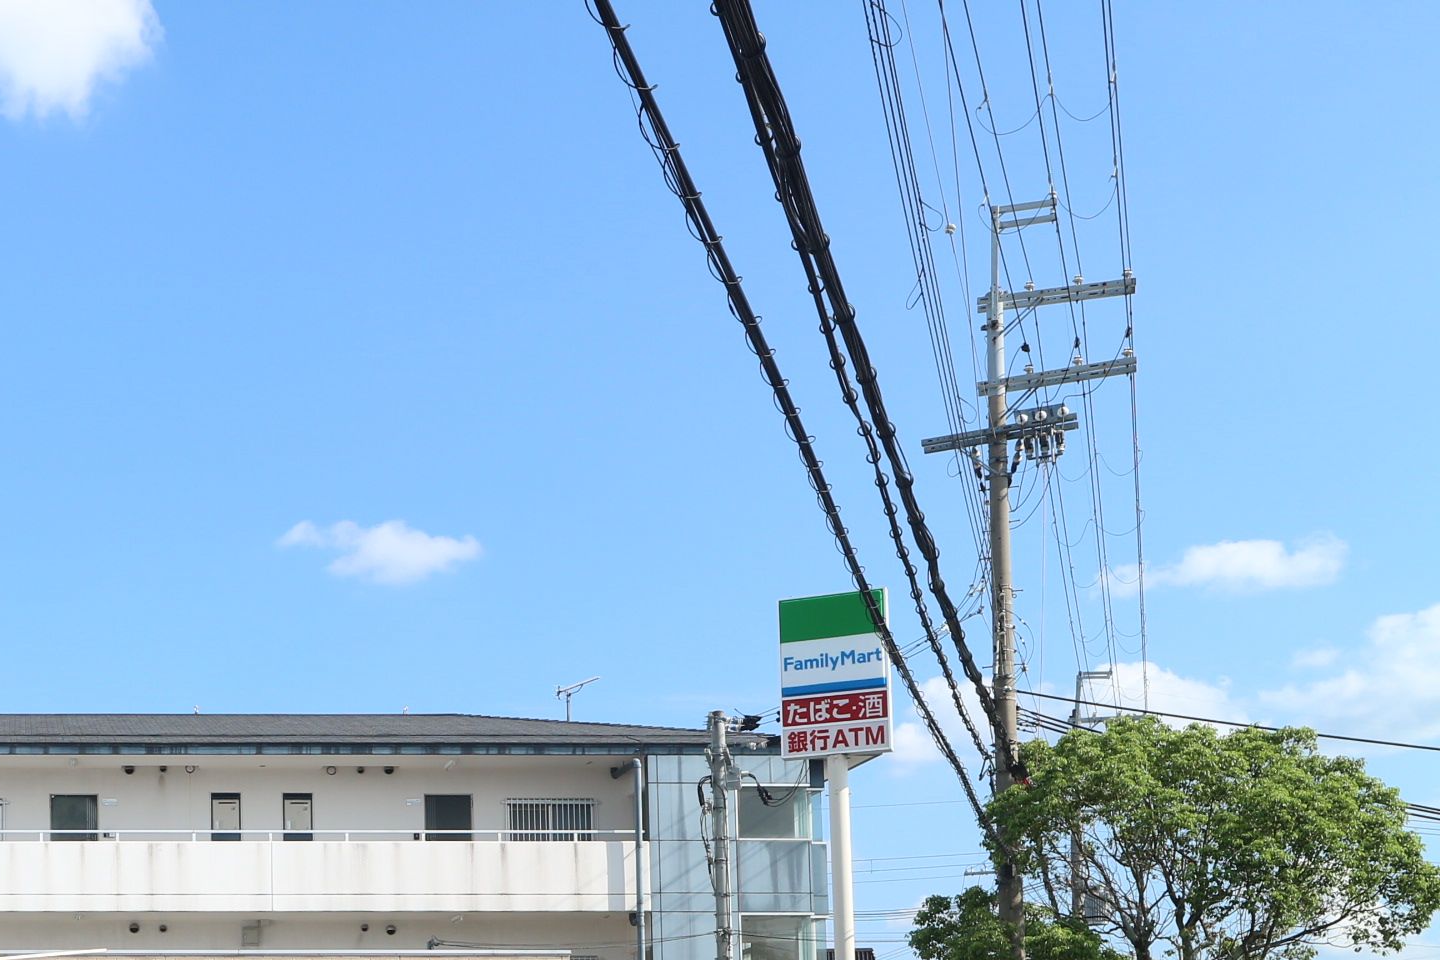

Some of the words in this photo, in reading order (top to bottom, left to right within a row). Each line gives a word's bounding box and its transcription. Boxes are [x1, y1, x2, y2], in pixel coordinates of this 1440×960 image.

[783, 648, 883, 672] FamilyMart
[787, 693, 884, 724] たばこ・酒
[787, 725, 886, 753] 銀行ATM
